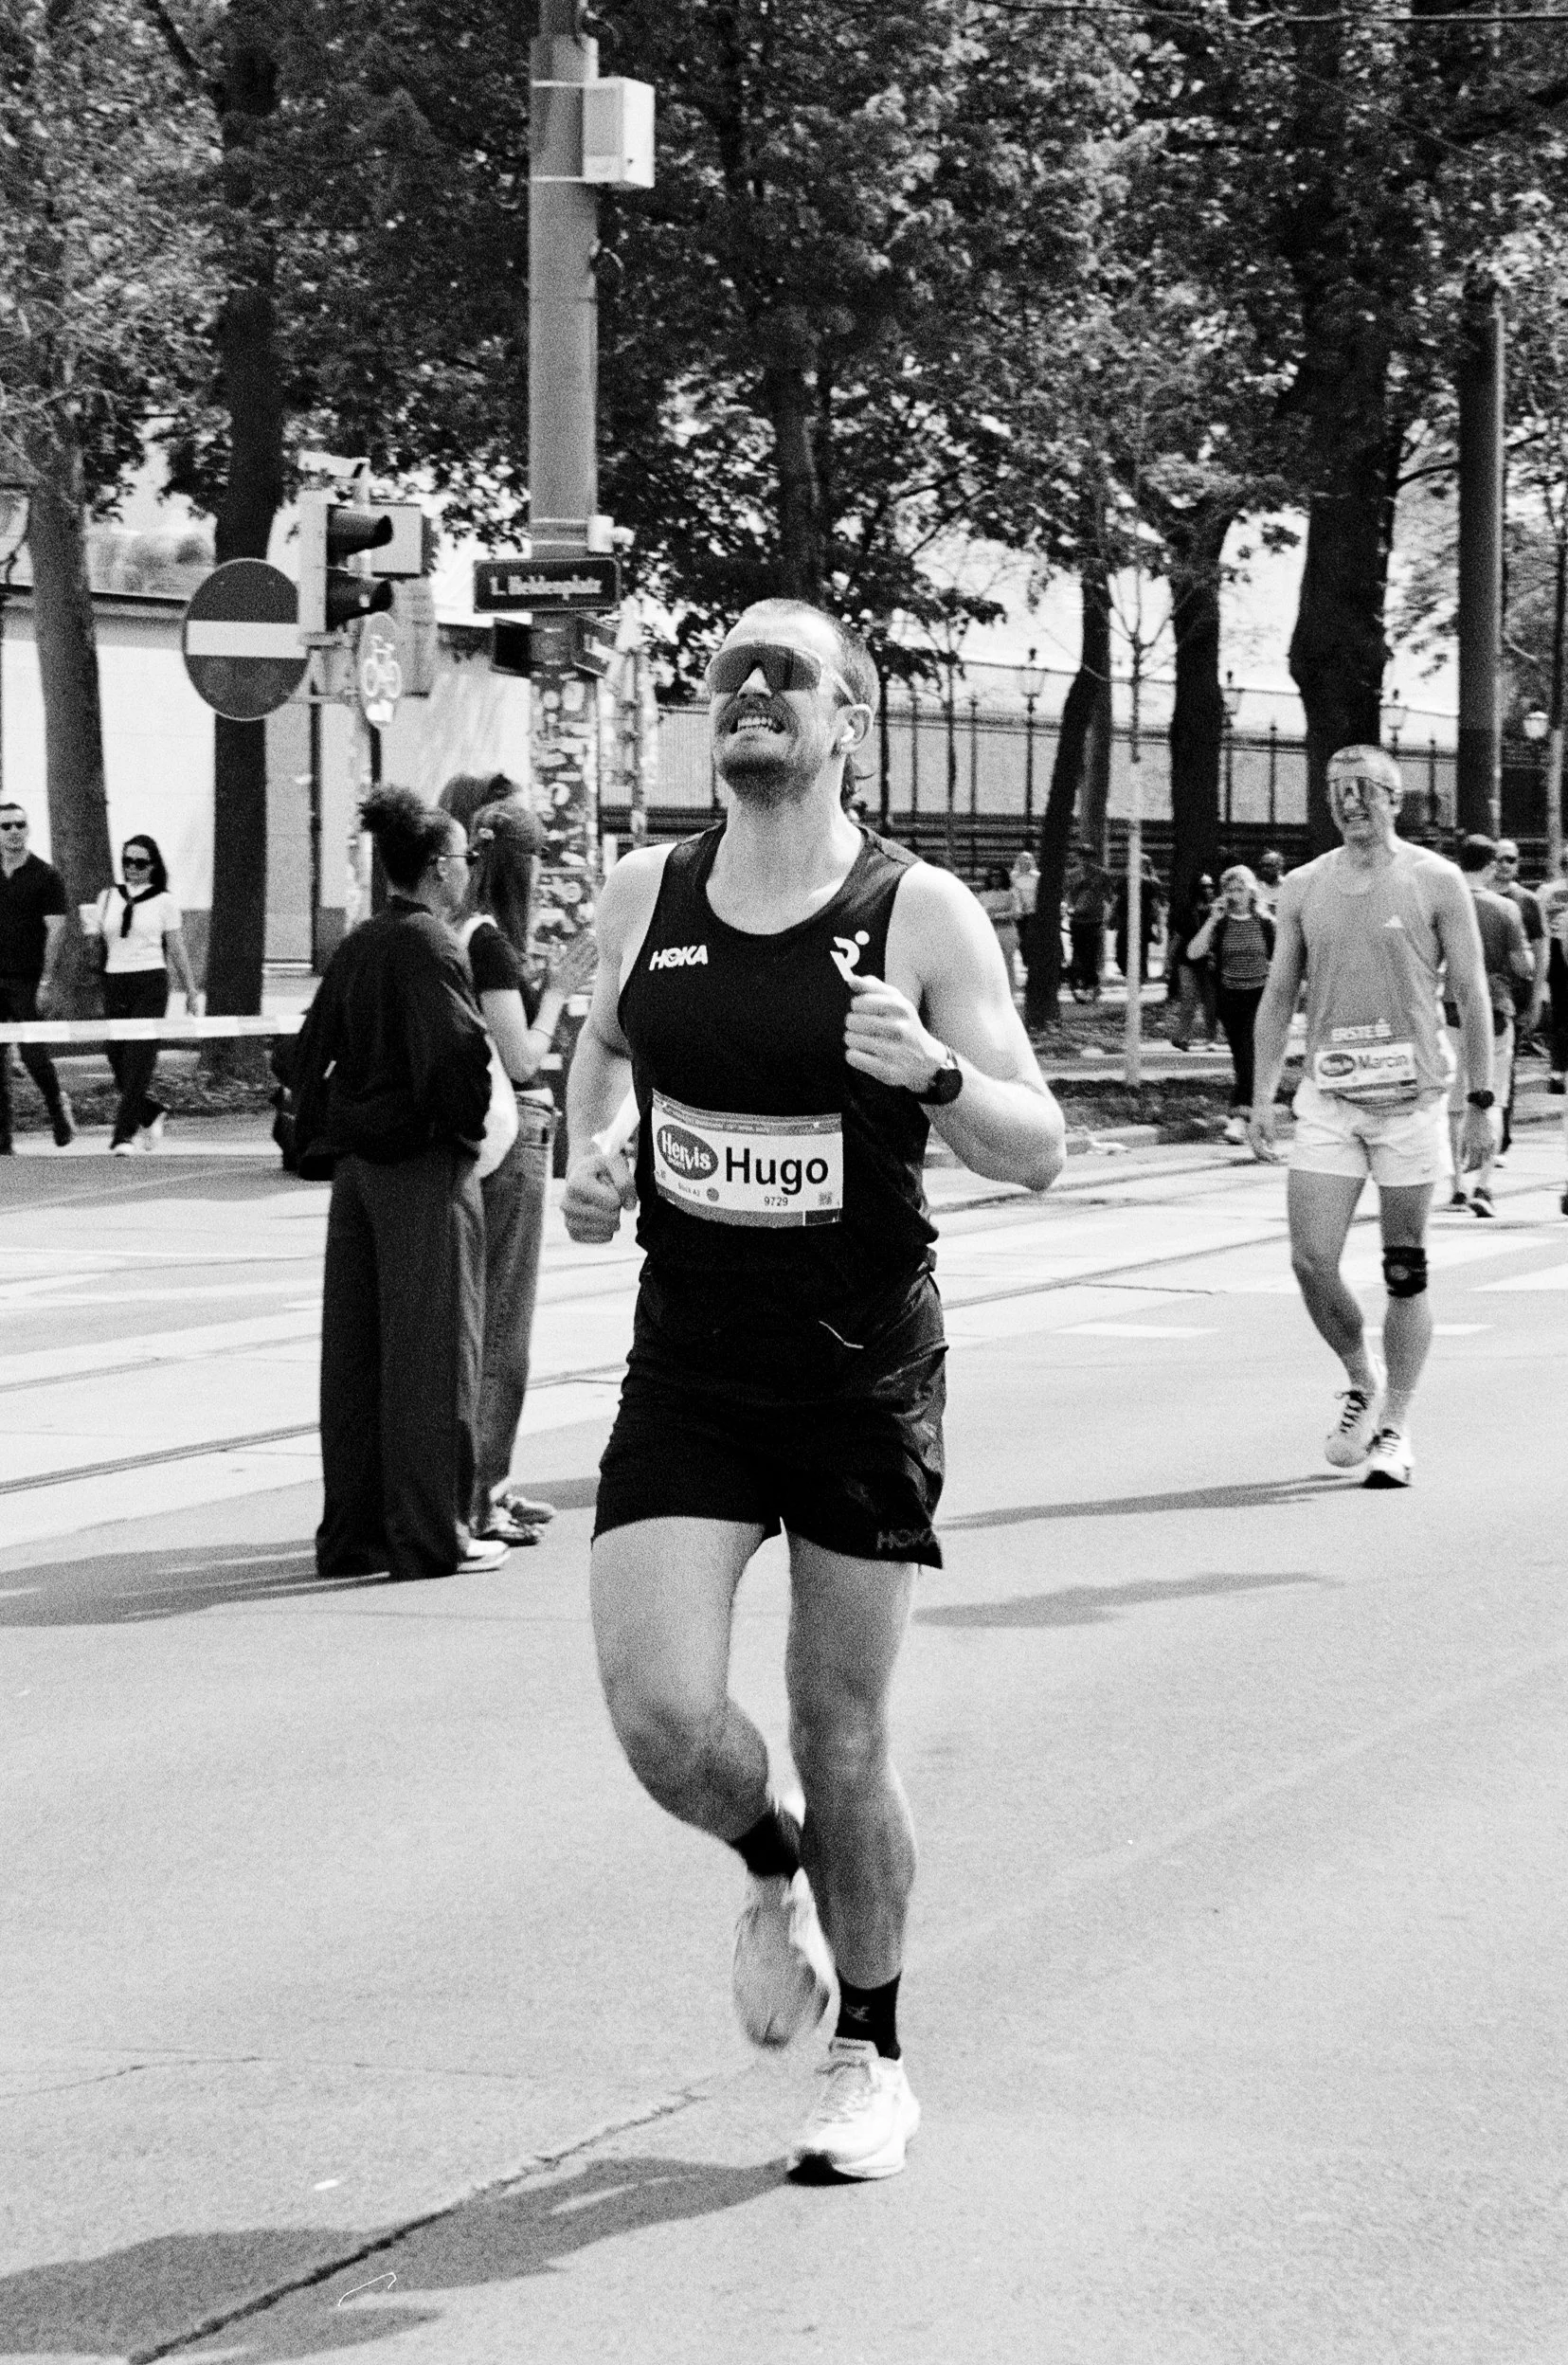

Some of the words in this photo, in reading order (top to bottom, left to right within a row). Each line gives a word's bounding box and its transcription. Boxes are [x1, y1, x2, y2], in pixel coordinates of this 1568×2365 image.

[648, 944, 709, 971] HOKA
[661, 1129, 712, 1170] Hervis
[726, 1146, 829, 1196] Hugo
[764, 1196, 788, 1207] 9729
